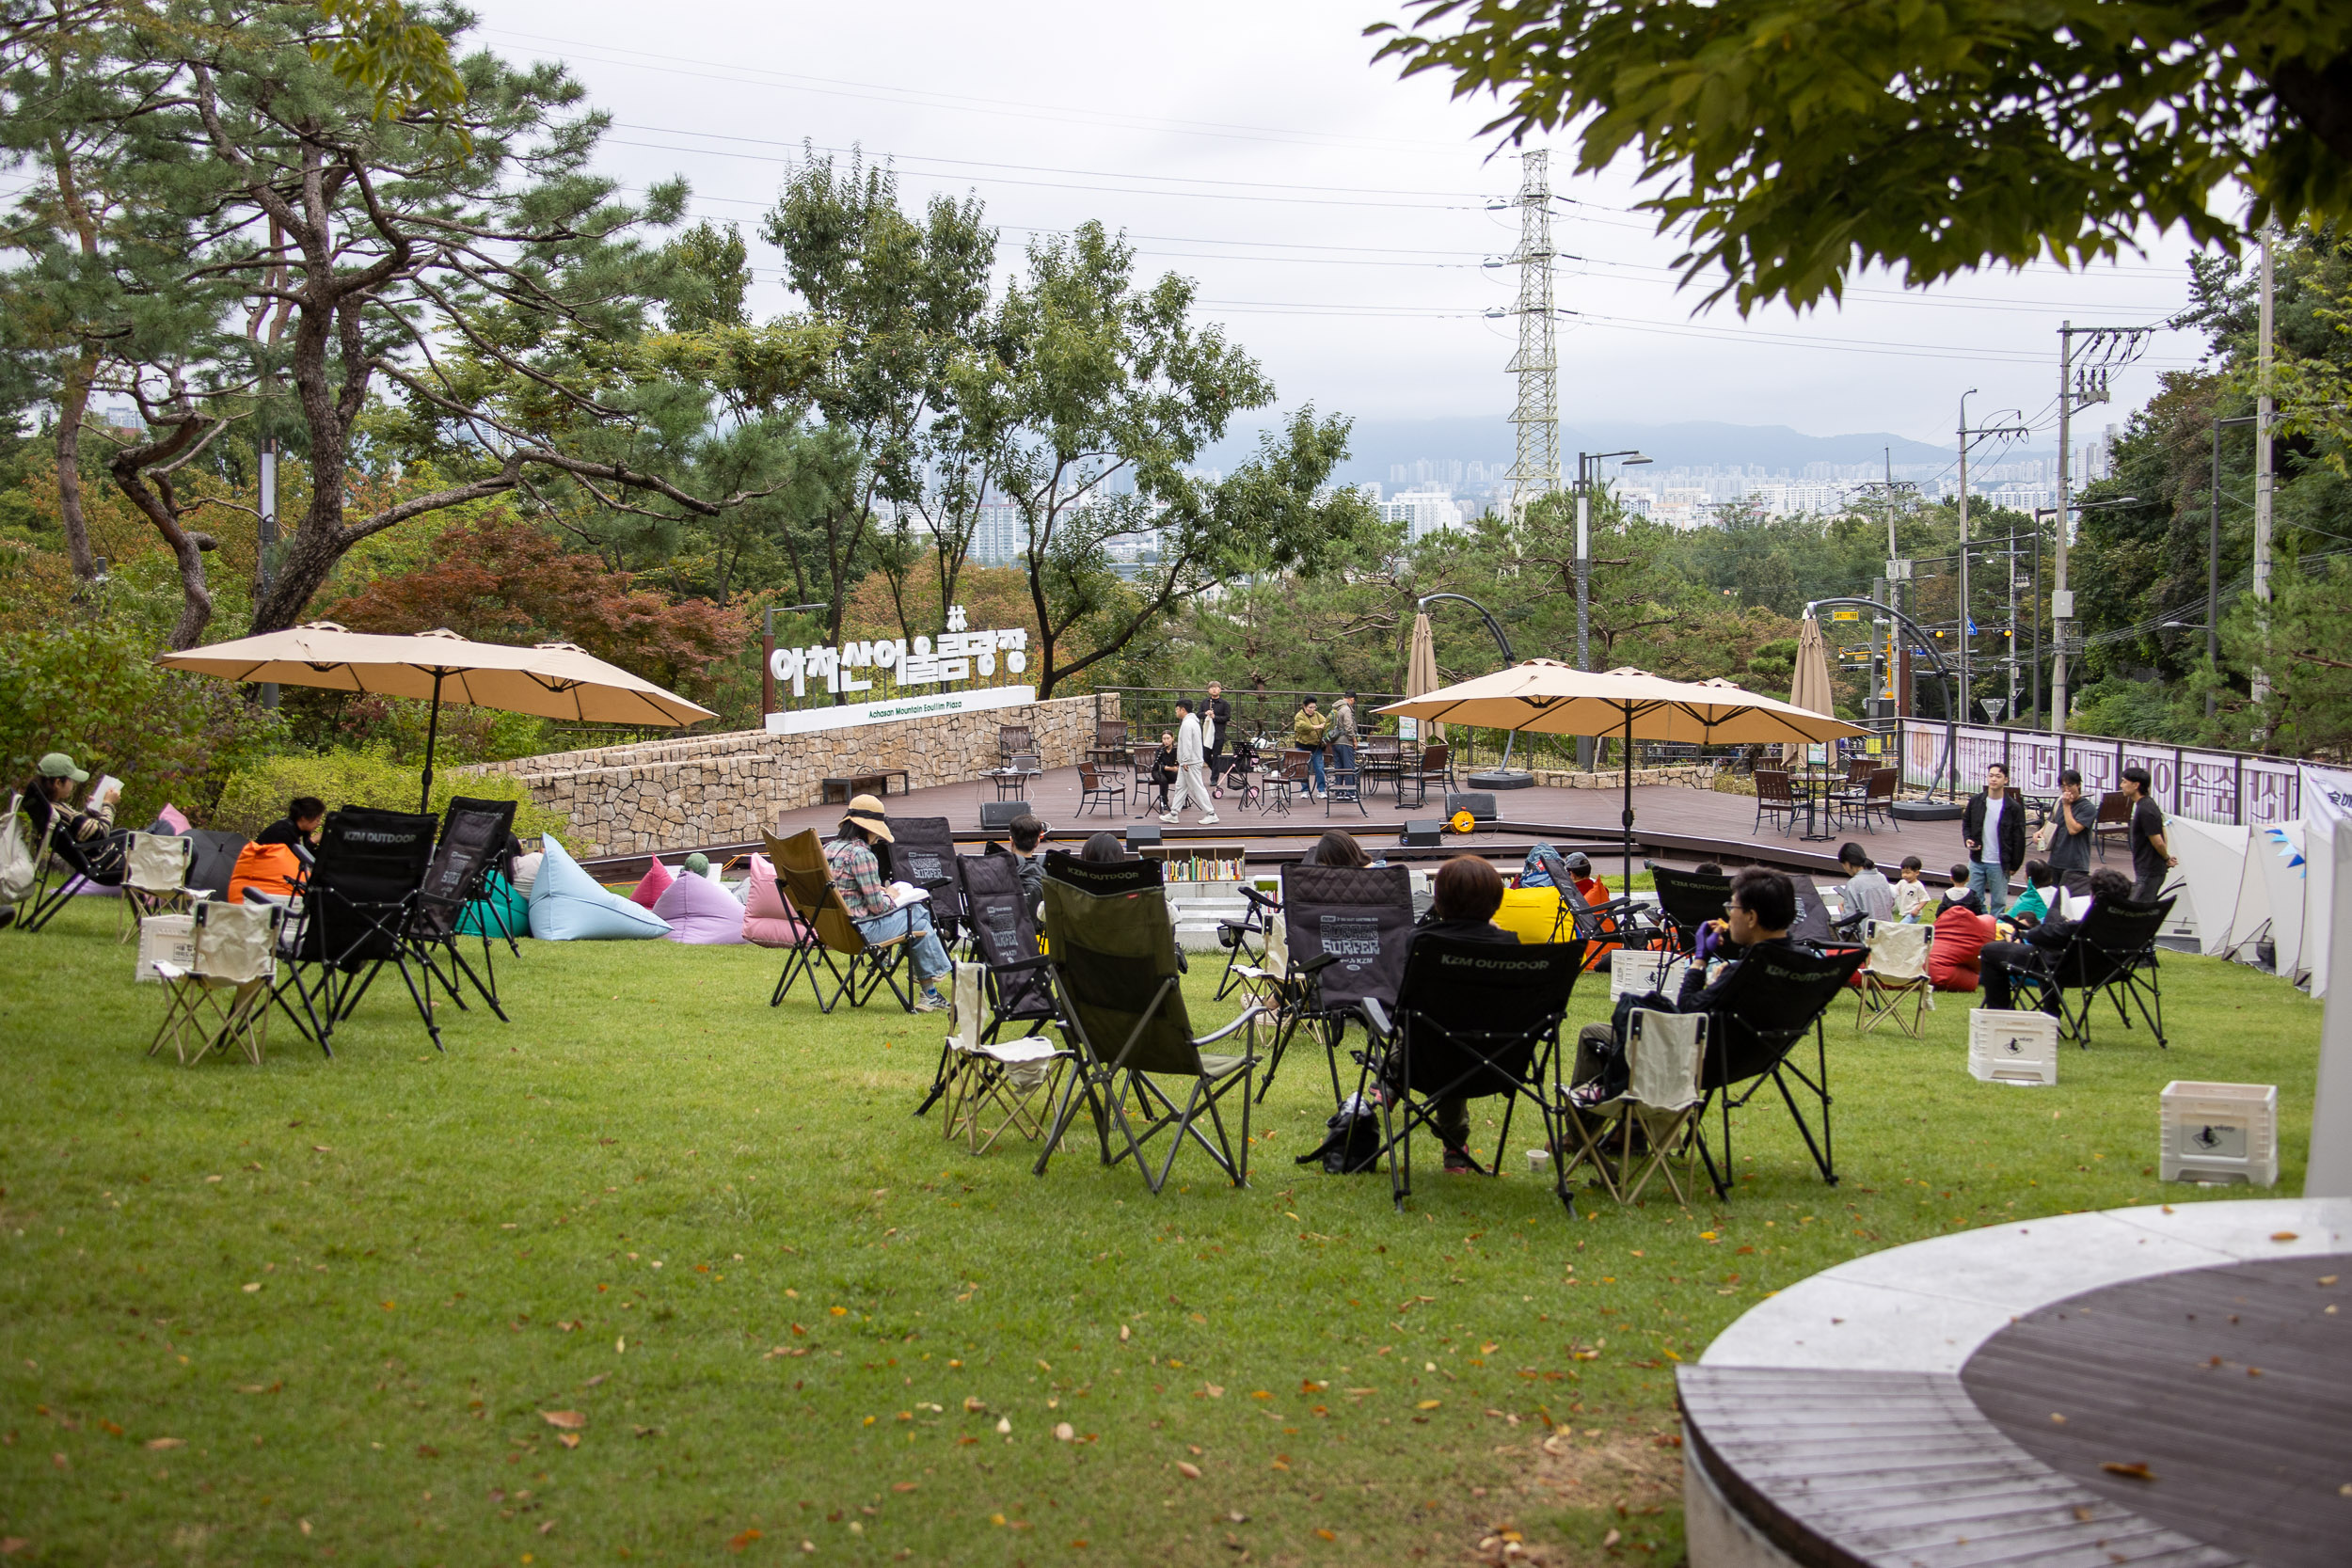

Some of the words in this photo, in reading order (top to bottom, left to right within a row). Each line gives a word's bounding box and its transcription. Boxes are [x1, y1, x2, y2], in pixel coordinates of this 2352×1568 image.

[868, 710, 895, 719] Achasan
[896, 705, 923, 716] Mountain
[343, 831, 365, 841] KZM
[1067, 866, 1089, 878] KZM
[1089, 872, 1139, 880] OUTDOOR
[1321, 940, 1380, 955] SURFER
[1441, 954, 1473, 967] KZM
[1475, 959, 1549, 971] OUTDOOR
